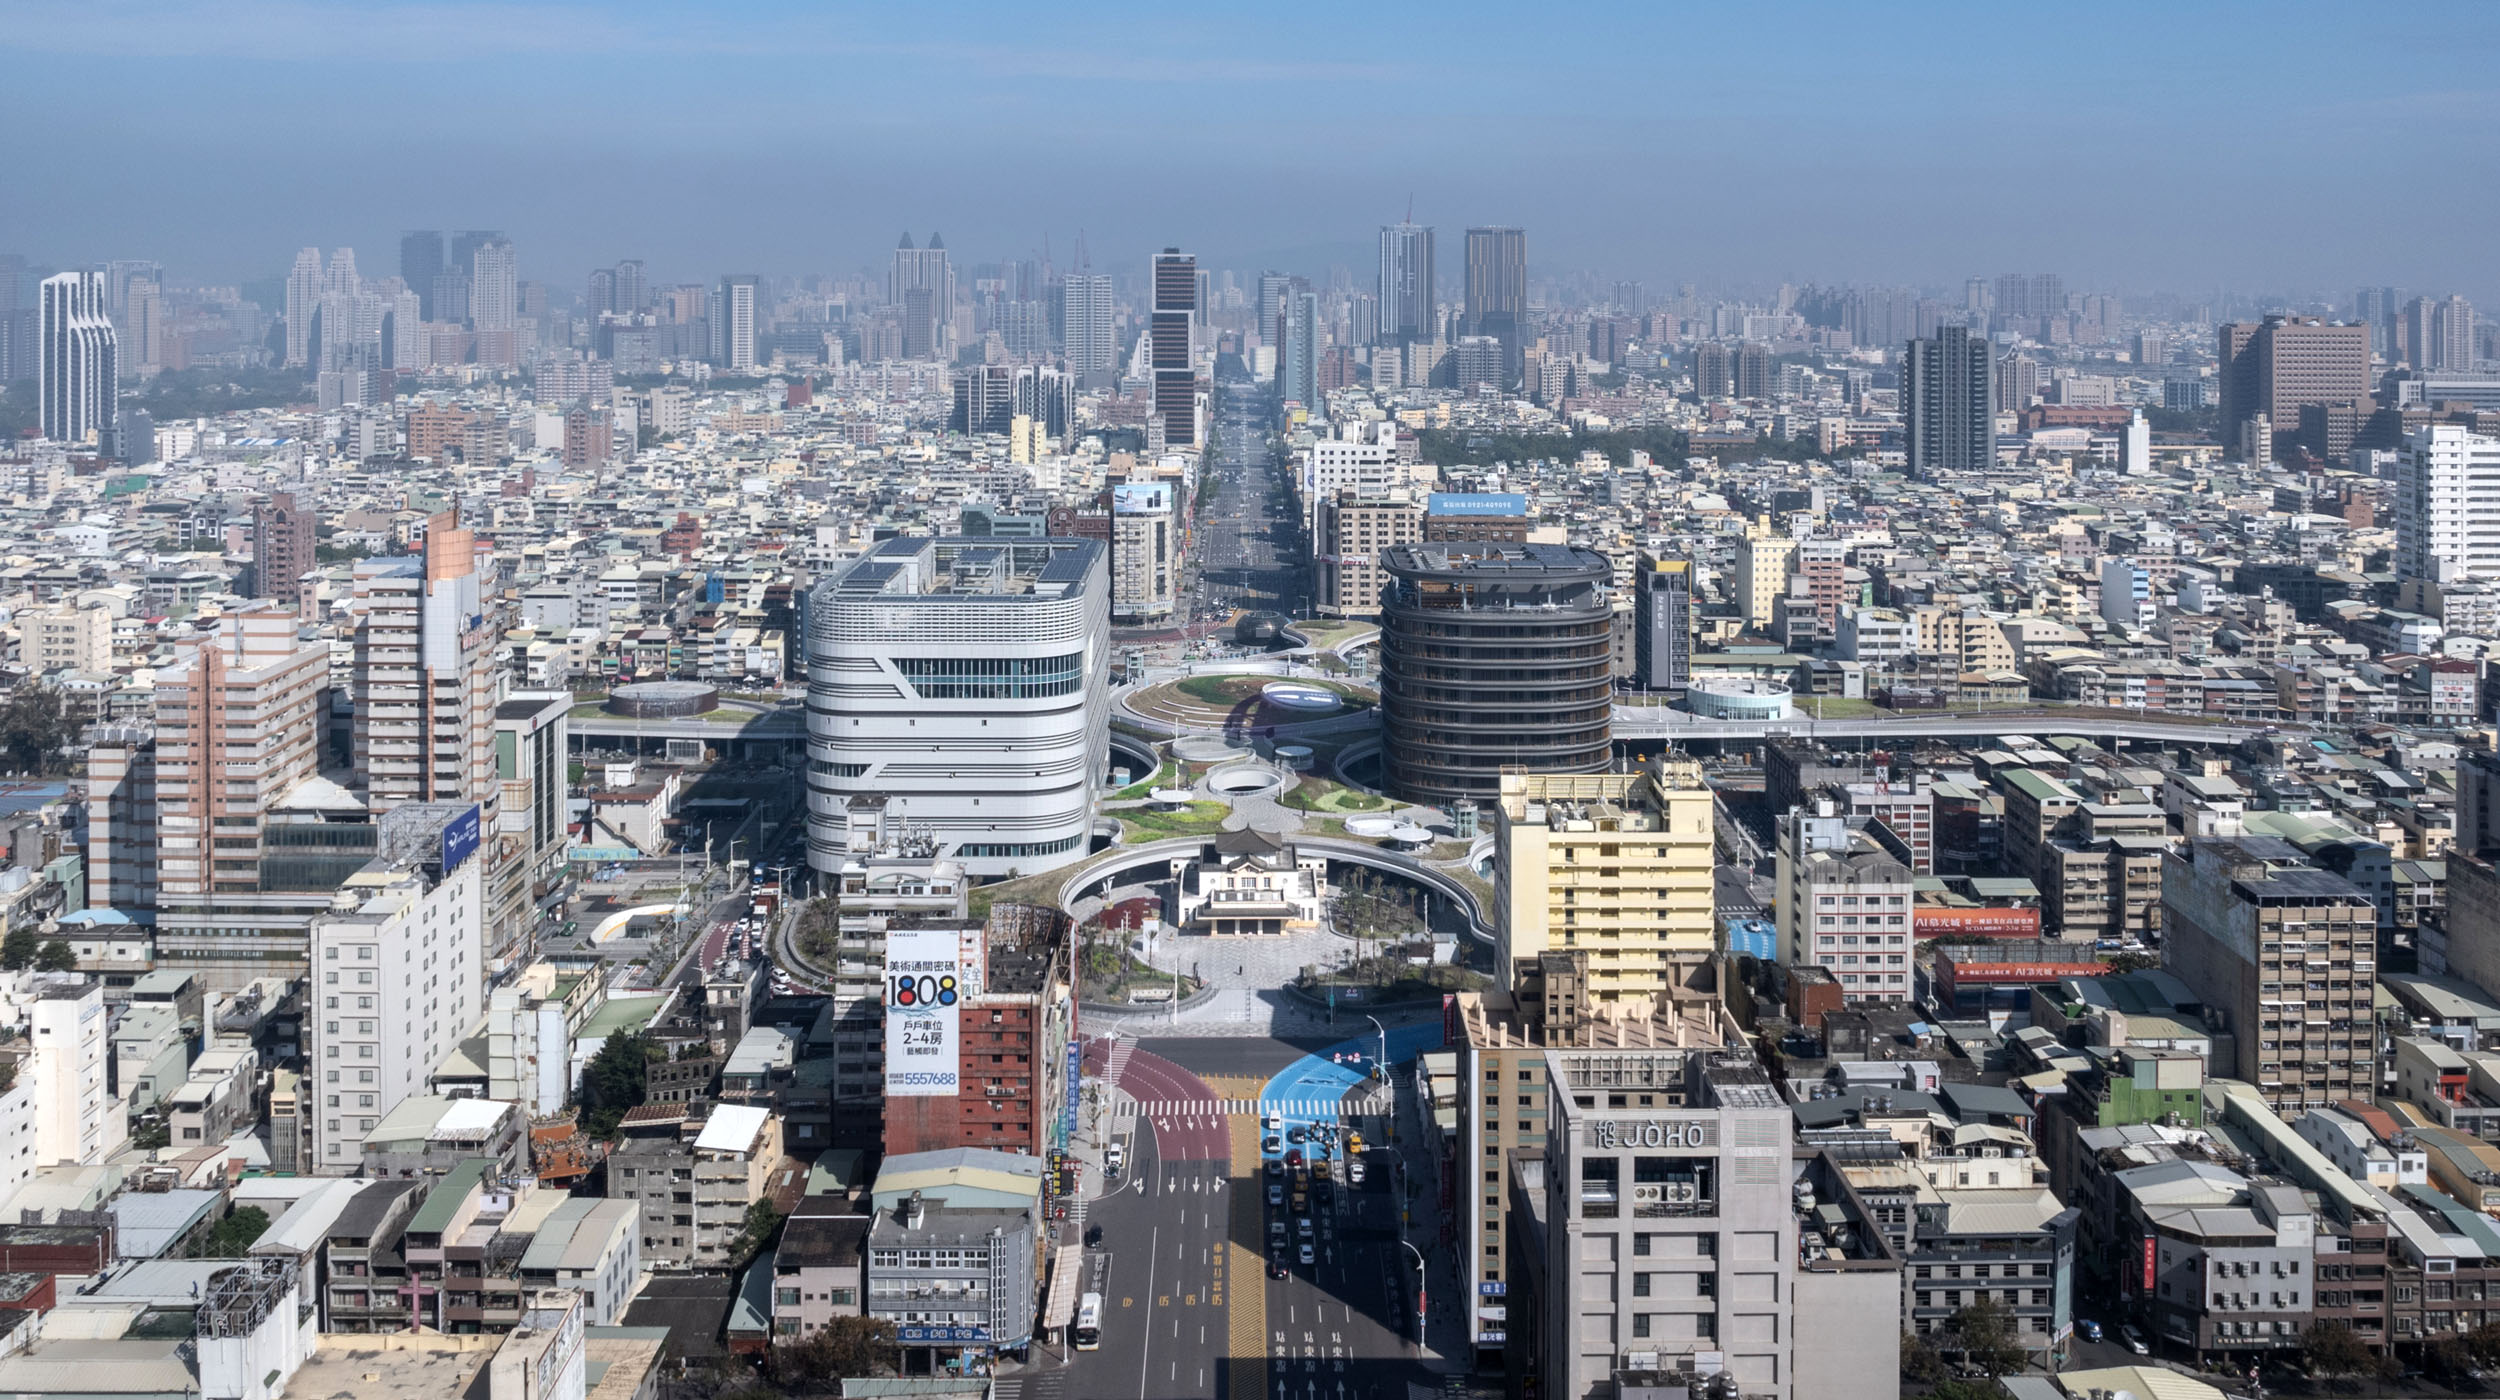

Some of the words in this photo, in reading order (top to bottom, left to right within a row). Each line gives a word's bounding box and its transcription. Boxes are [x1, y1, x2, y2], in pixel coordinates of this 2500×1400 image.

[888, 960, 957, 973] 美術通關密碼
[888, 975, 958, 1007] 1808
[903, 1020, 943, 1031] 戶戶車位
[903, 1032, 943, 1045] 2-4房
[904, 1072, 957, 1085] 5557688
[1158, 1295, 1170, 1307] 50
[1185, 1294, 1196, 1306] 50
[1212, 1294, 1223, 1306] 50
